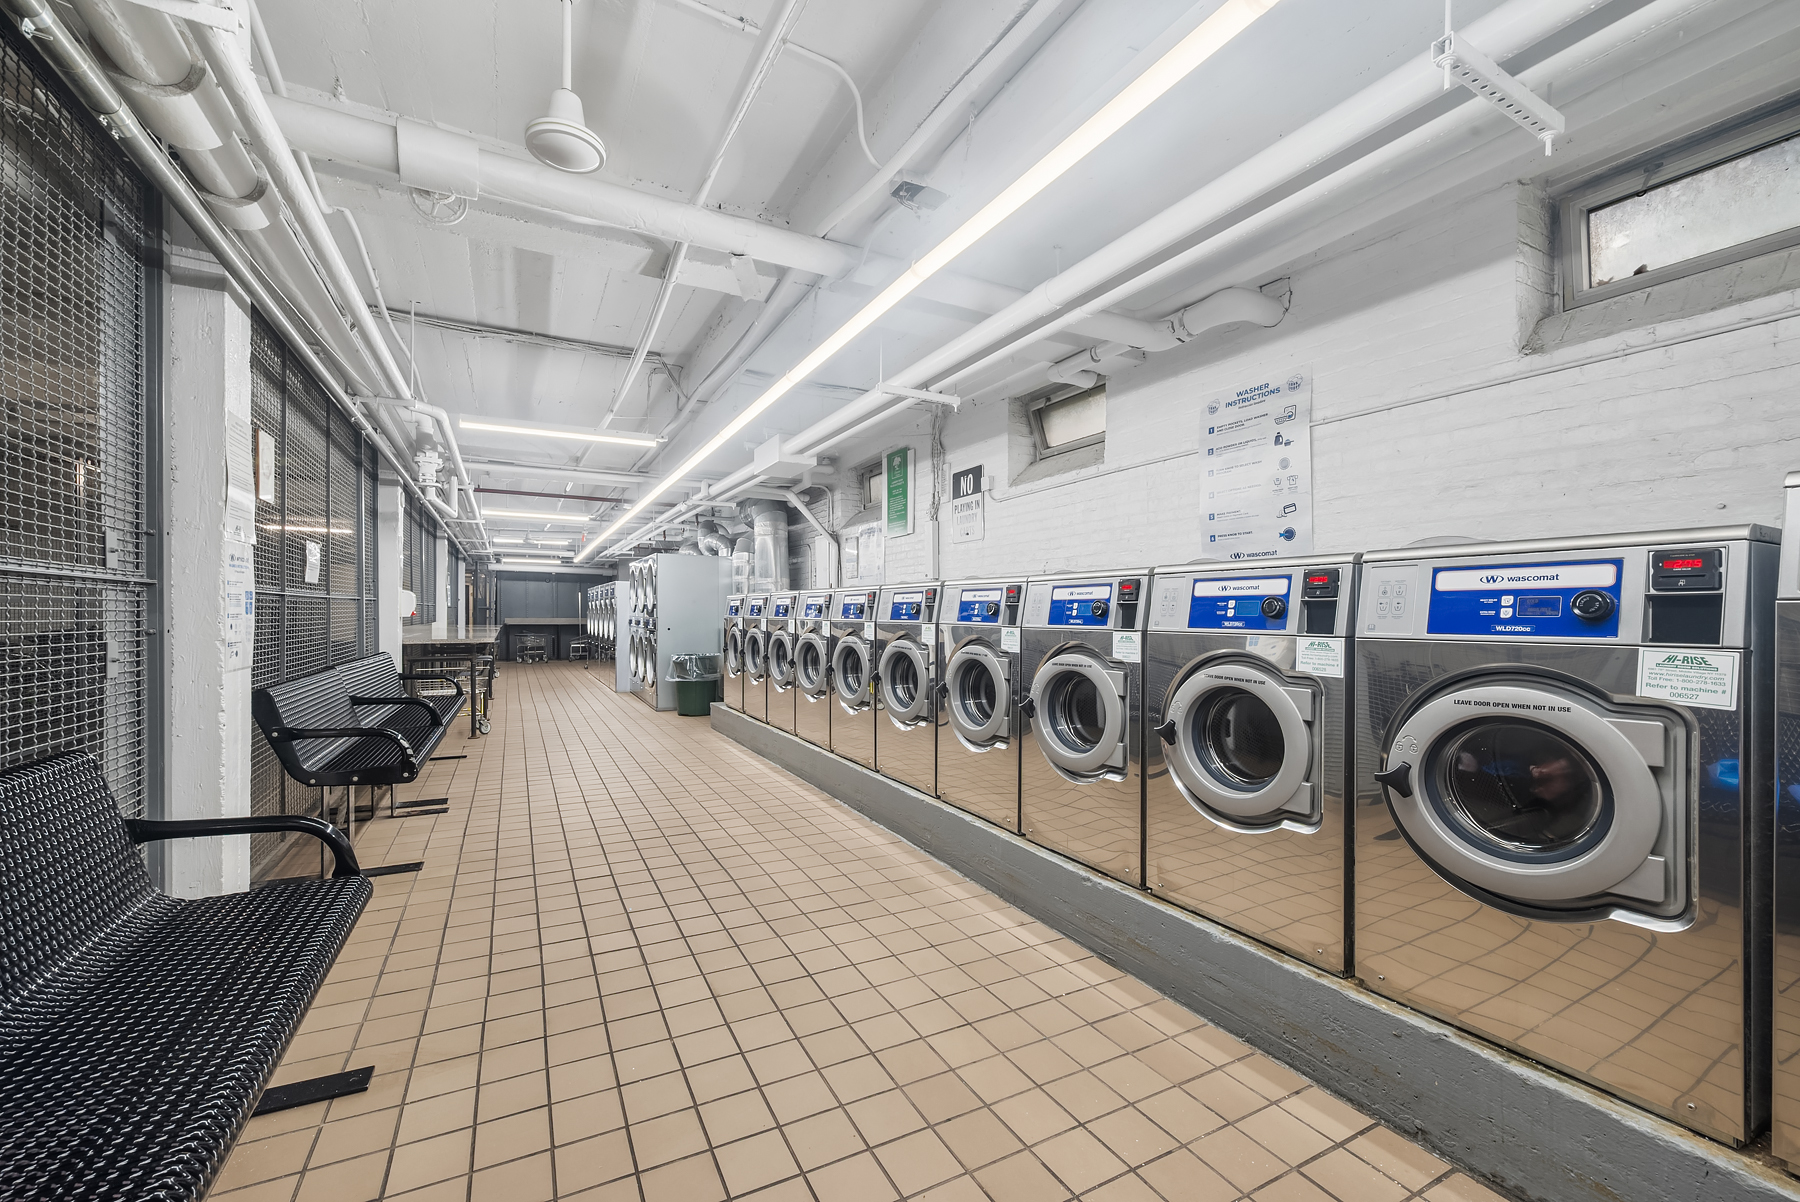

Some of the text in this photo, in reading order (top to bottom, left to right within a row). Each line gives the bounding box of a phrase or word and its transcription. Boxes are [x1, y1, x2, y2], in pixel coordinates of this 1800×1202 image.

[1236, 383, 1269, 397] WASHER
[1226, 387, 1280, 408] INSTRUCTIONS
[960, 474, 973, 496] NO
[954, 499, 980, 514] PLAYING IN
[957, 512, 978, 526] LAUNDRY
[1506, 573, 1560, 582] wascomat
[1662, 654, 1713, 666] HI-RISE
[1648, 671, 1724, 681] www.hiriselaundry.com
[1676, 678, 1726, 687] 1-800-278-1633
[1669, 692, 1700, 700] 006527
[1681, 686, 1718, 694] machine
